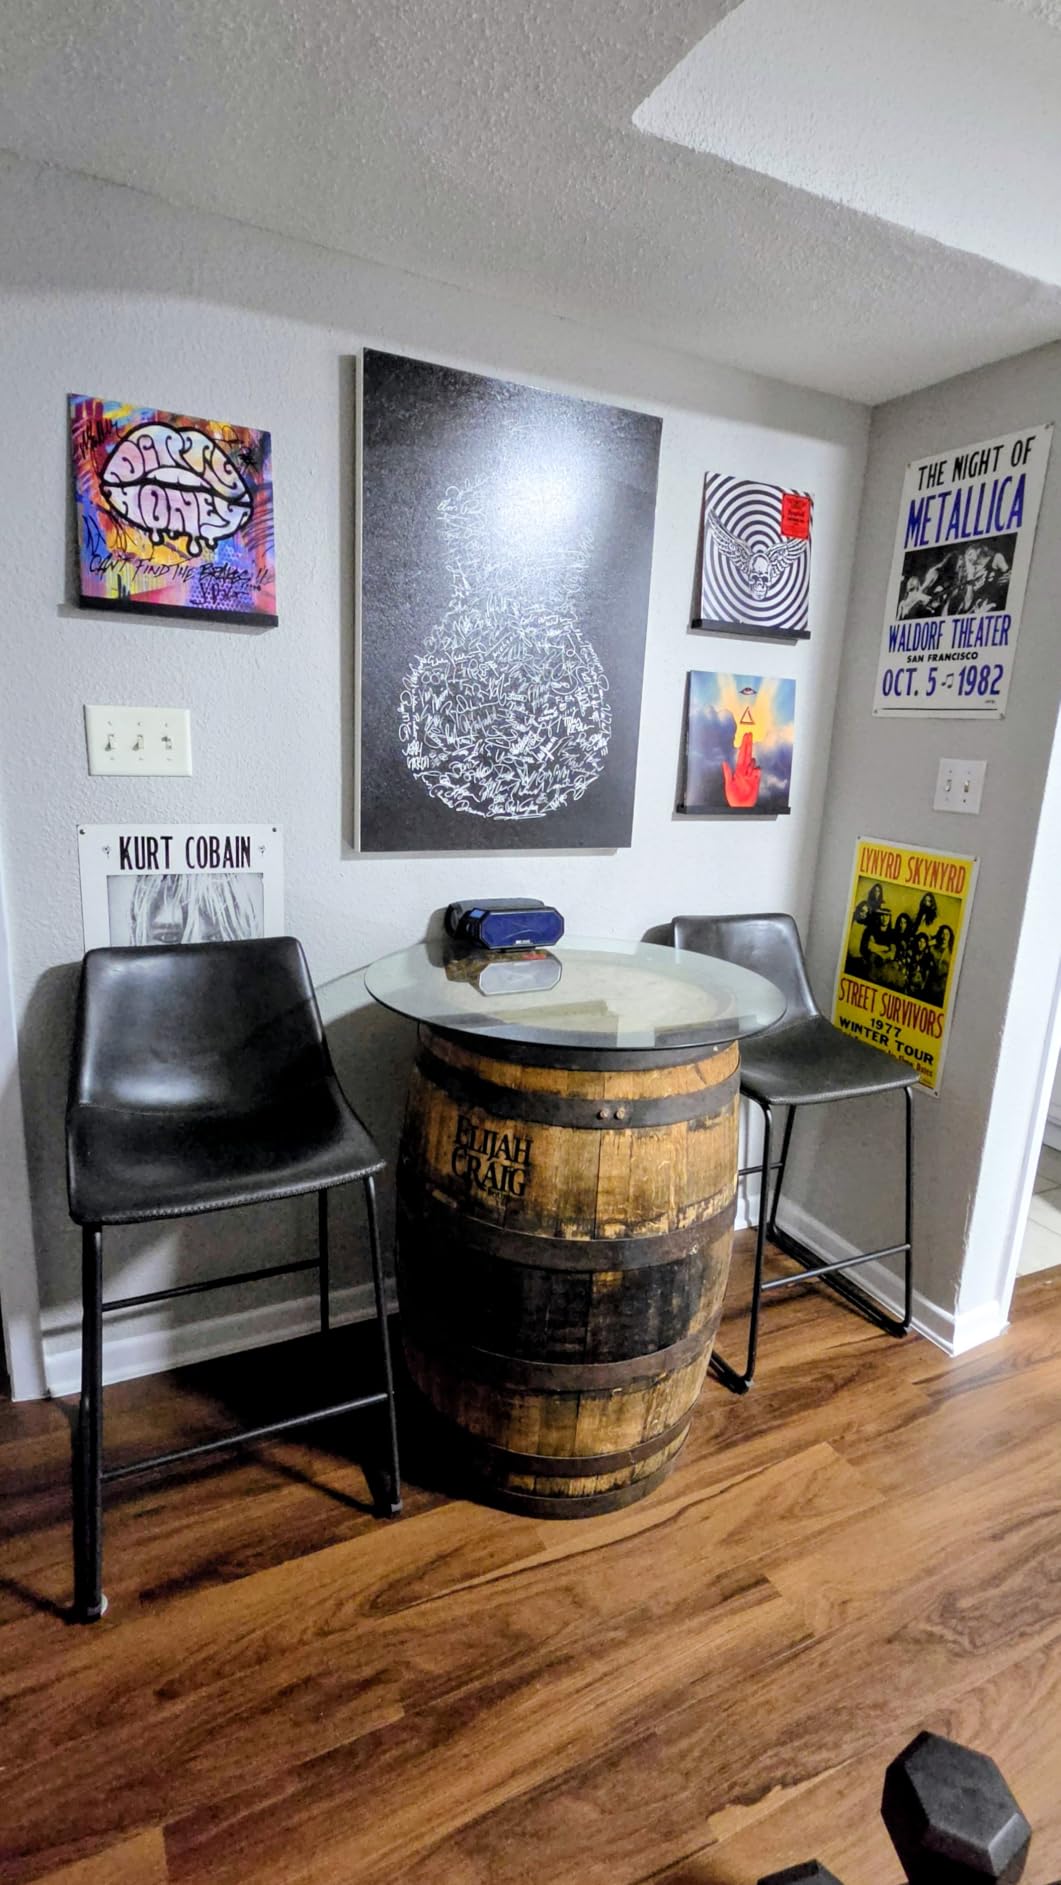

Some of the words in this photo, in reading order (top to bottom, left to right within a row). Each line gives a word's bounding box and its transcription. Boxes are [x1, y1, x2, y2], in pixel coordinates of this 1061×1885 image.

[918, 460, 947, 491] THE
[952, 445, 1004, 482] NIGHT
[1010, 435, 1036, 467] OF
[904, 473, 1026, 549] METALLICA
[132, 560, 170, 581] FIND
[888, 621, 945, 653] WALDORF
[951, 614, 1012, 649] THEATER
[882, 667, 918, 697] OCT.
[926, 667, 938, 697] 5
[958, 664, 1004, 697] 1982
[907, 654, 924, 663] SAN
[927, 652, 979, 663] FRANCISCO
[119, 836, 173, 870] KURT
[185, 836, 251, 869] COBAIN
[860, 847, 902, 881] LYNYRD
[905, 855, 966, 894] SKYNYRD
[838, 977, 878, 1013] STREET
[880, 992, 944, 1039] SURVIVORS
[870, 1017, 902, 1037] 1977
[839, 1016, 890, 1047] WINTER
[895, 1038, 934, 1065] TOUR
[455, 1114, 534, 1166] ELIJAH
[452, 1147, 527, 1197] CRAIG
